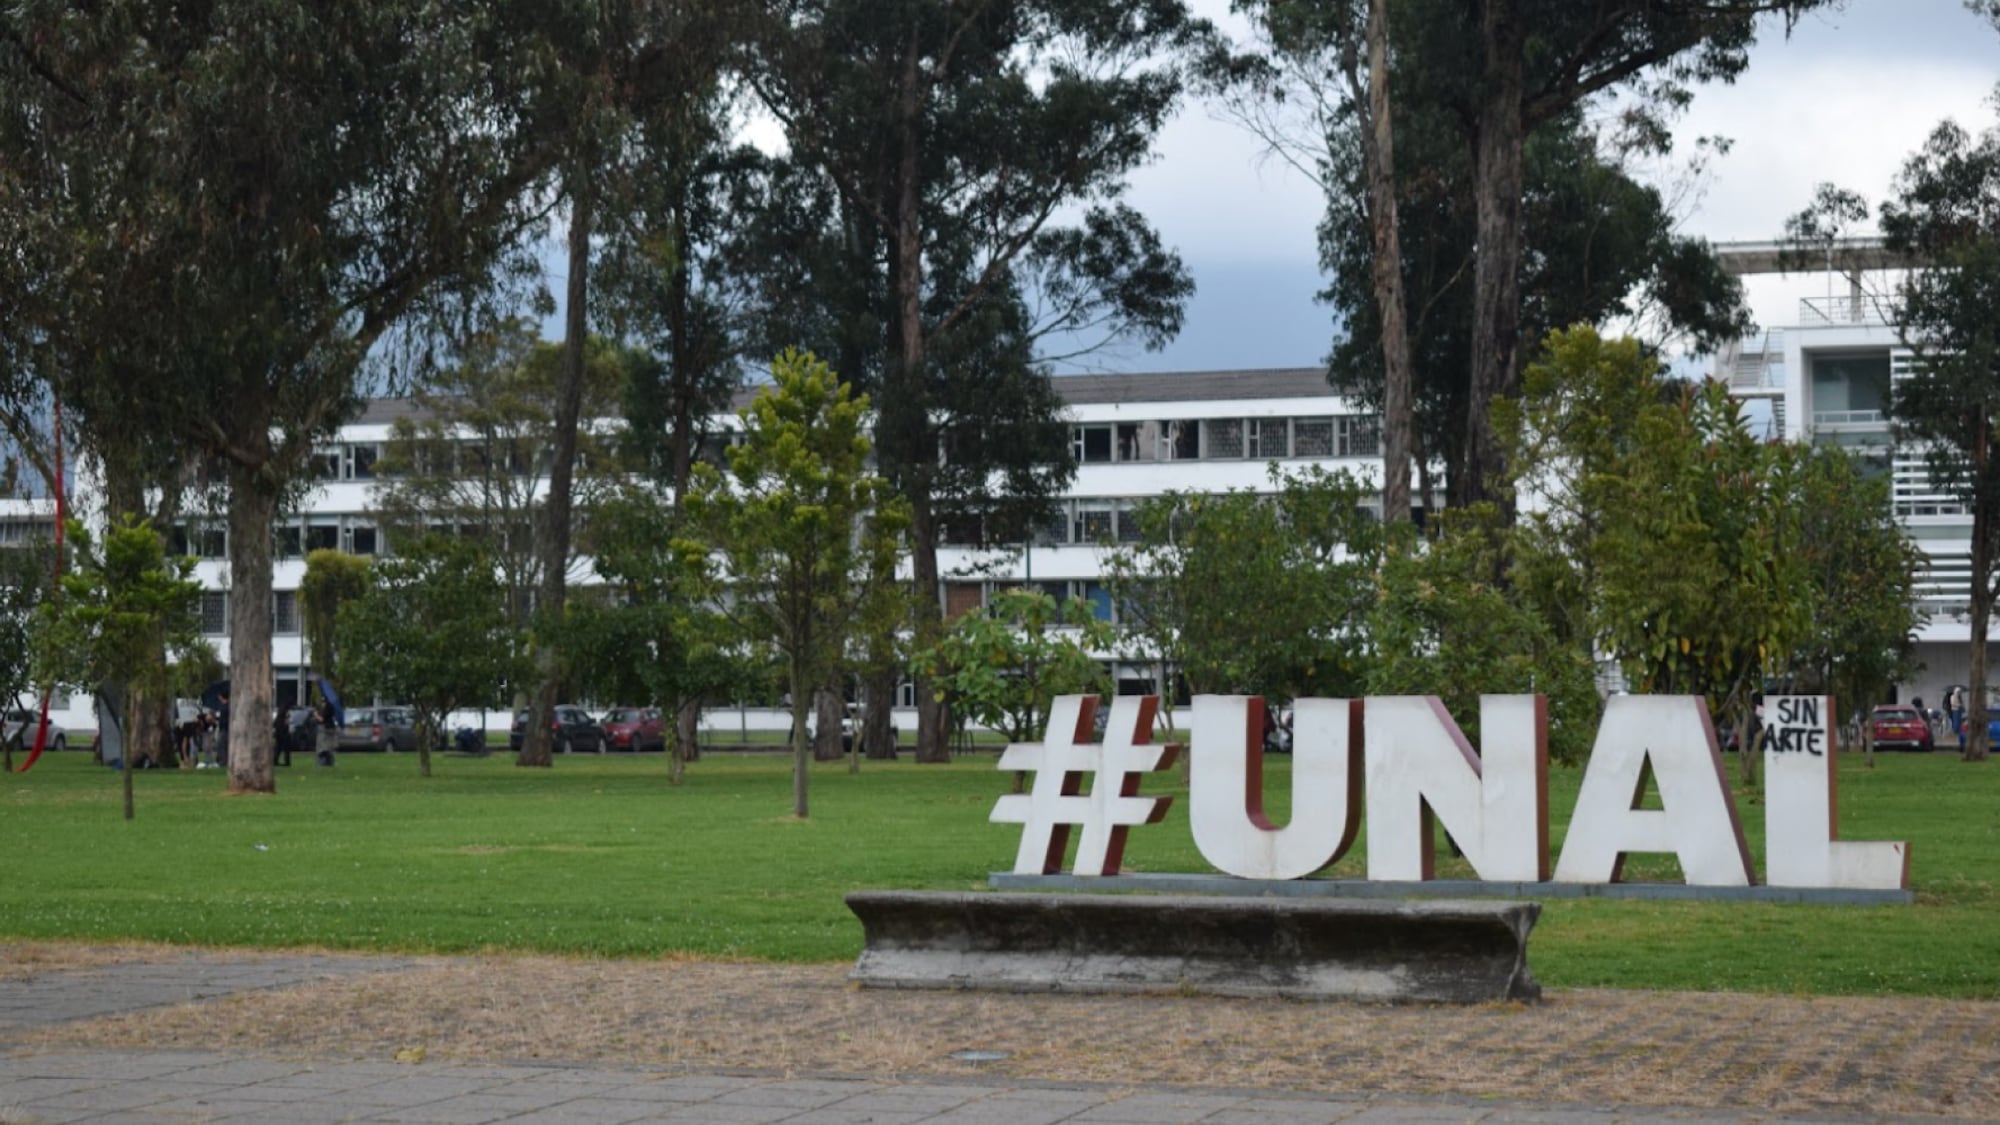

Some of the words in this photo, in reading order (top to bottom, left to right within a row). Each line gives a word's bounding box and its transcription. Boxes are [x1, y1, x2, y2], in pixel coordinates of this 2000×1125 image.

[1777, 697, 1819, 726] SIN
[1764, 724, 1824, 756] ARTE
[989, 694, 1908, 890] #UNAL
